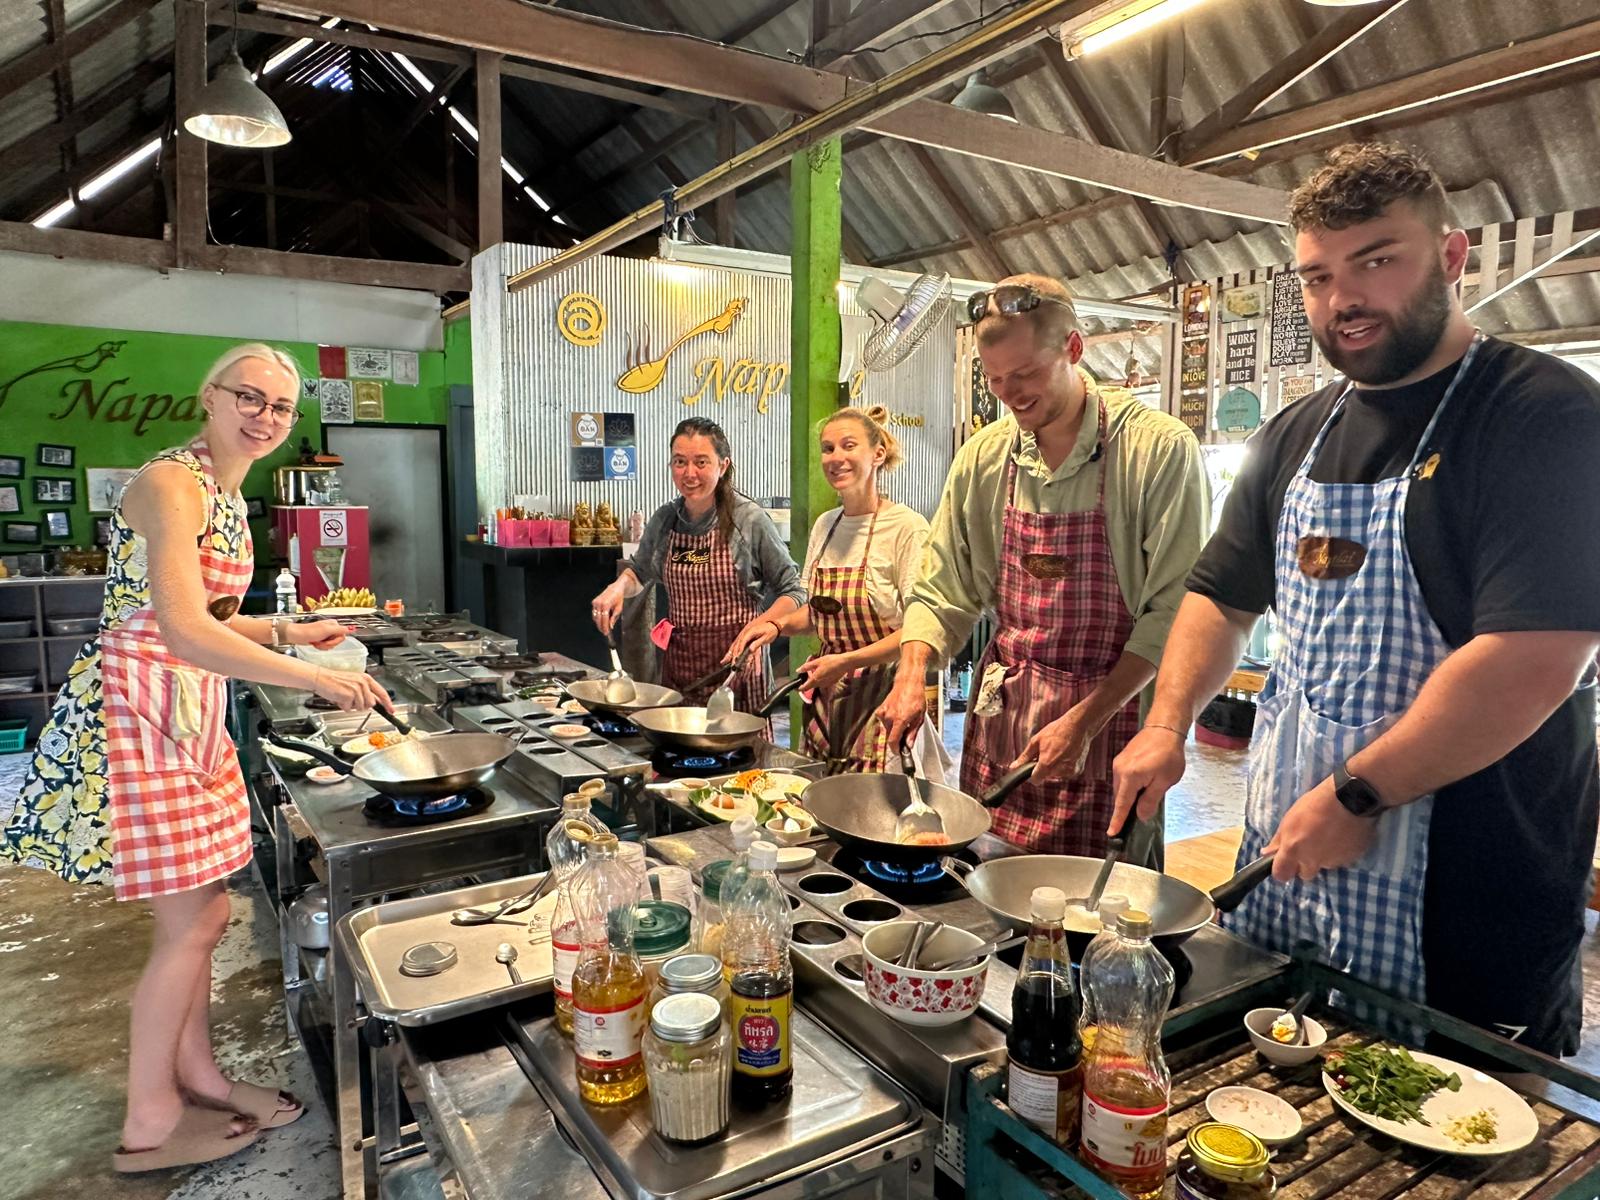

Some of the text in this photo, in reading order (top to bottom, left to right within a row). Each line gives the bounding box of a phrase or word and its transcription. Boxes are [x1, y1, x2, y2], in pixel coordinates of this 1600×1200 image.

[1275, 286, 1299, 295] LISTEN
[1275, 293, 1293, 301] TALK
[1274, 300, 1292, 308] LOVE
[1274, 305, 1298, 314] ARGUE
[1274, 312, 1292, 321] HOPE
[1274, 319, 1292, 327] FEAR
[1273, 325, 1296, 333] RELAX
[1228, 333, 1256, 346] WORK
[1273, 331, 1298, 340] WORRY
[1229, 345, 1253, 358] hard
[1272, 350, 1290, 359] PLAY
[1226, 357, 1255, 370] and Be
[1272, 357, 1293, 366] WORK
[1230, 370, 1250, 382] NICE
[48, 377, 208, 437] Napa
[1181, 402, 1205, 412] MUCH
[890, 412, 925, 428] School
